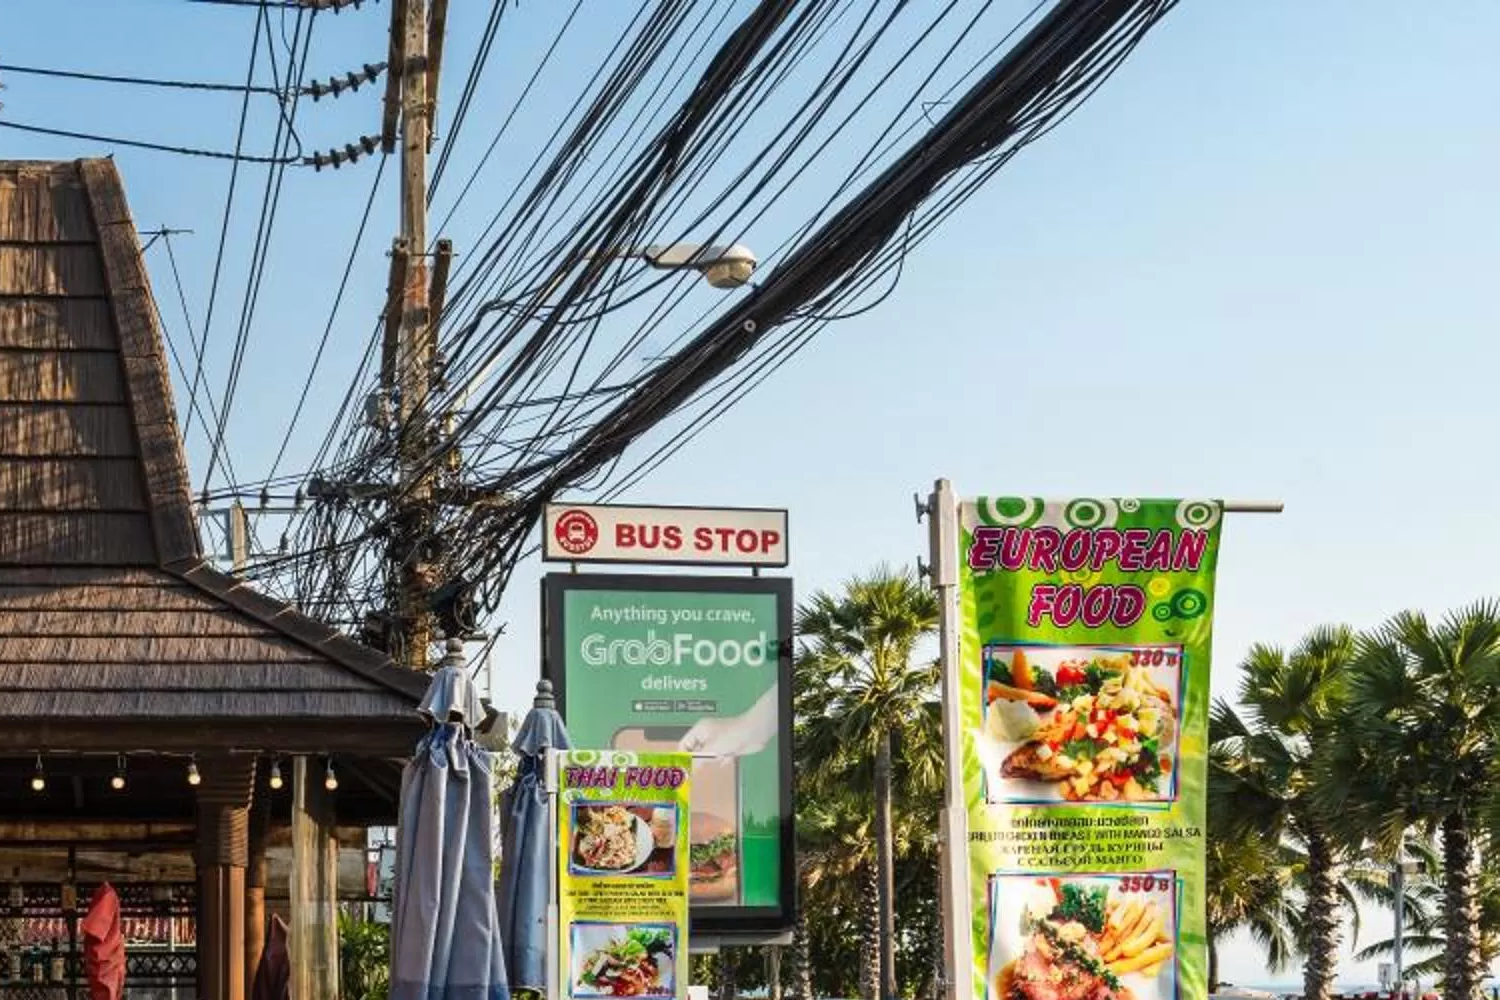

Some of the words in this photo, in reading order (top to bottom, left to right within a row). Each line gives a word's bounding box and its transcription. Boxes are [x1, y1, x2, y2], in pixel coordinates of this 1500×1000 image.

[615, 523, 683, 550] BUS
[693, 526, 781, 553] STOP
[969, 527, 1209, 573] EUROPEAN
[590, 605, 667, 625] Anything
[671, 608, 702, 625] you
[705, 607, 757, 624] crave,
[1028, 583, 1147, 628] FOOD
[580, 629, 768, 667] GrabFood
[641, 675, 708, 690] delivers
[564, 766, 620, 789] THAI
[624, 766, 687, 790] FOOD
[1163, 827, 1201, 839] SALSA
